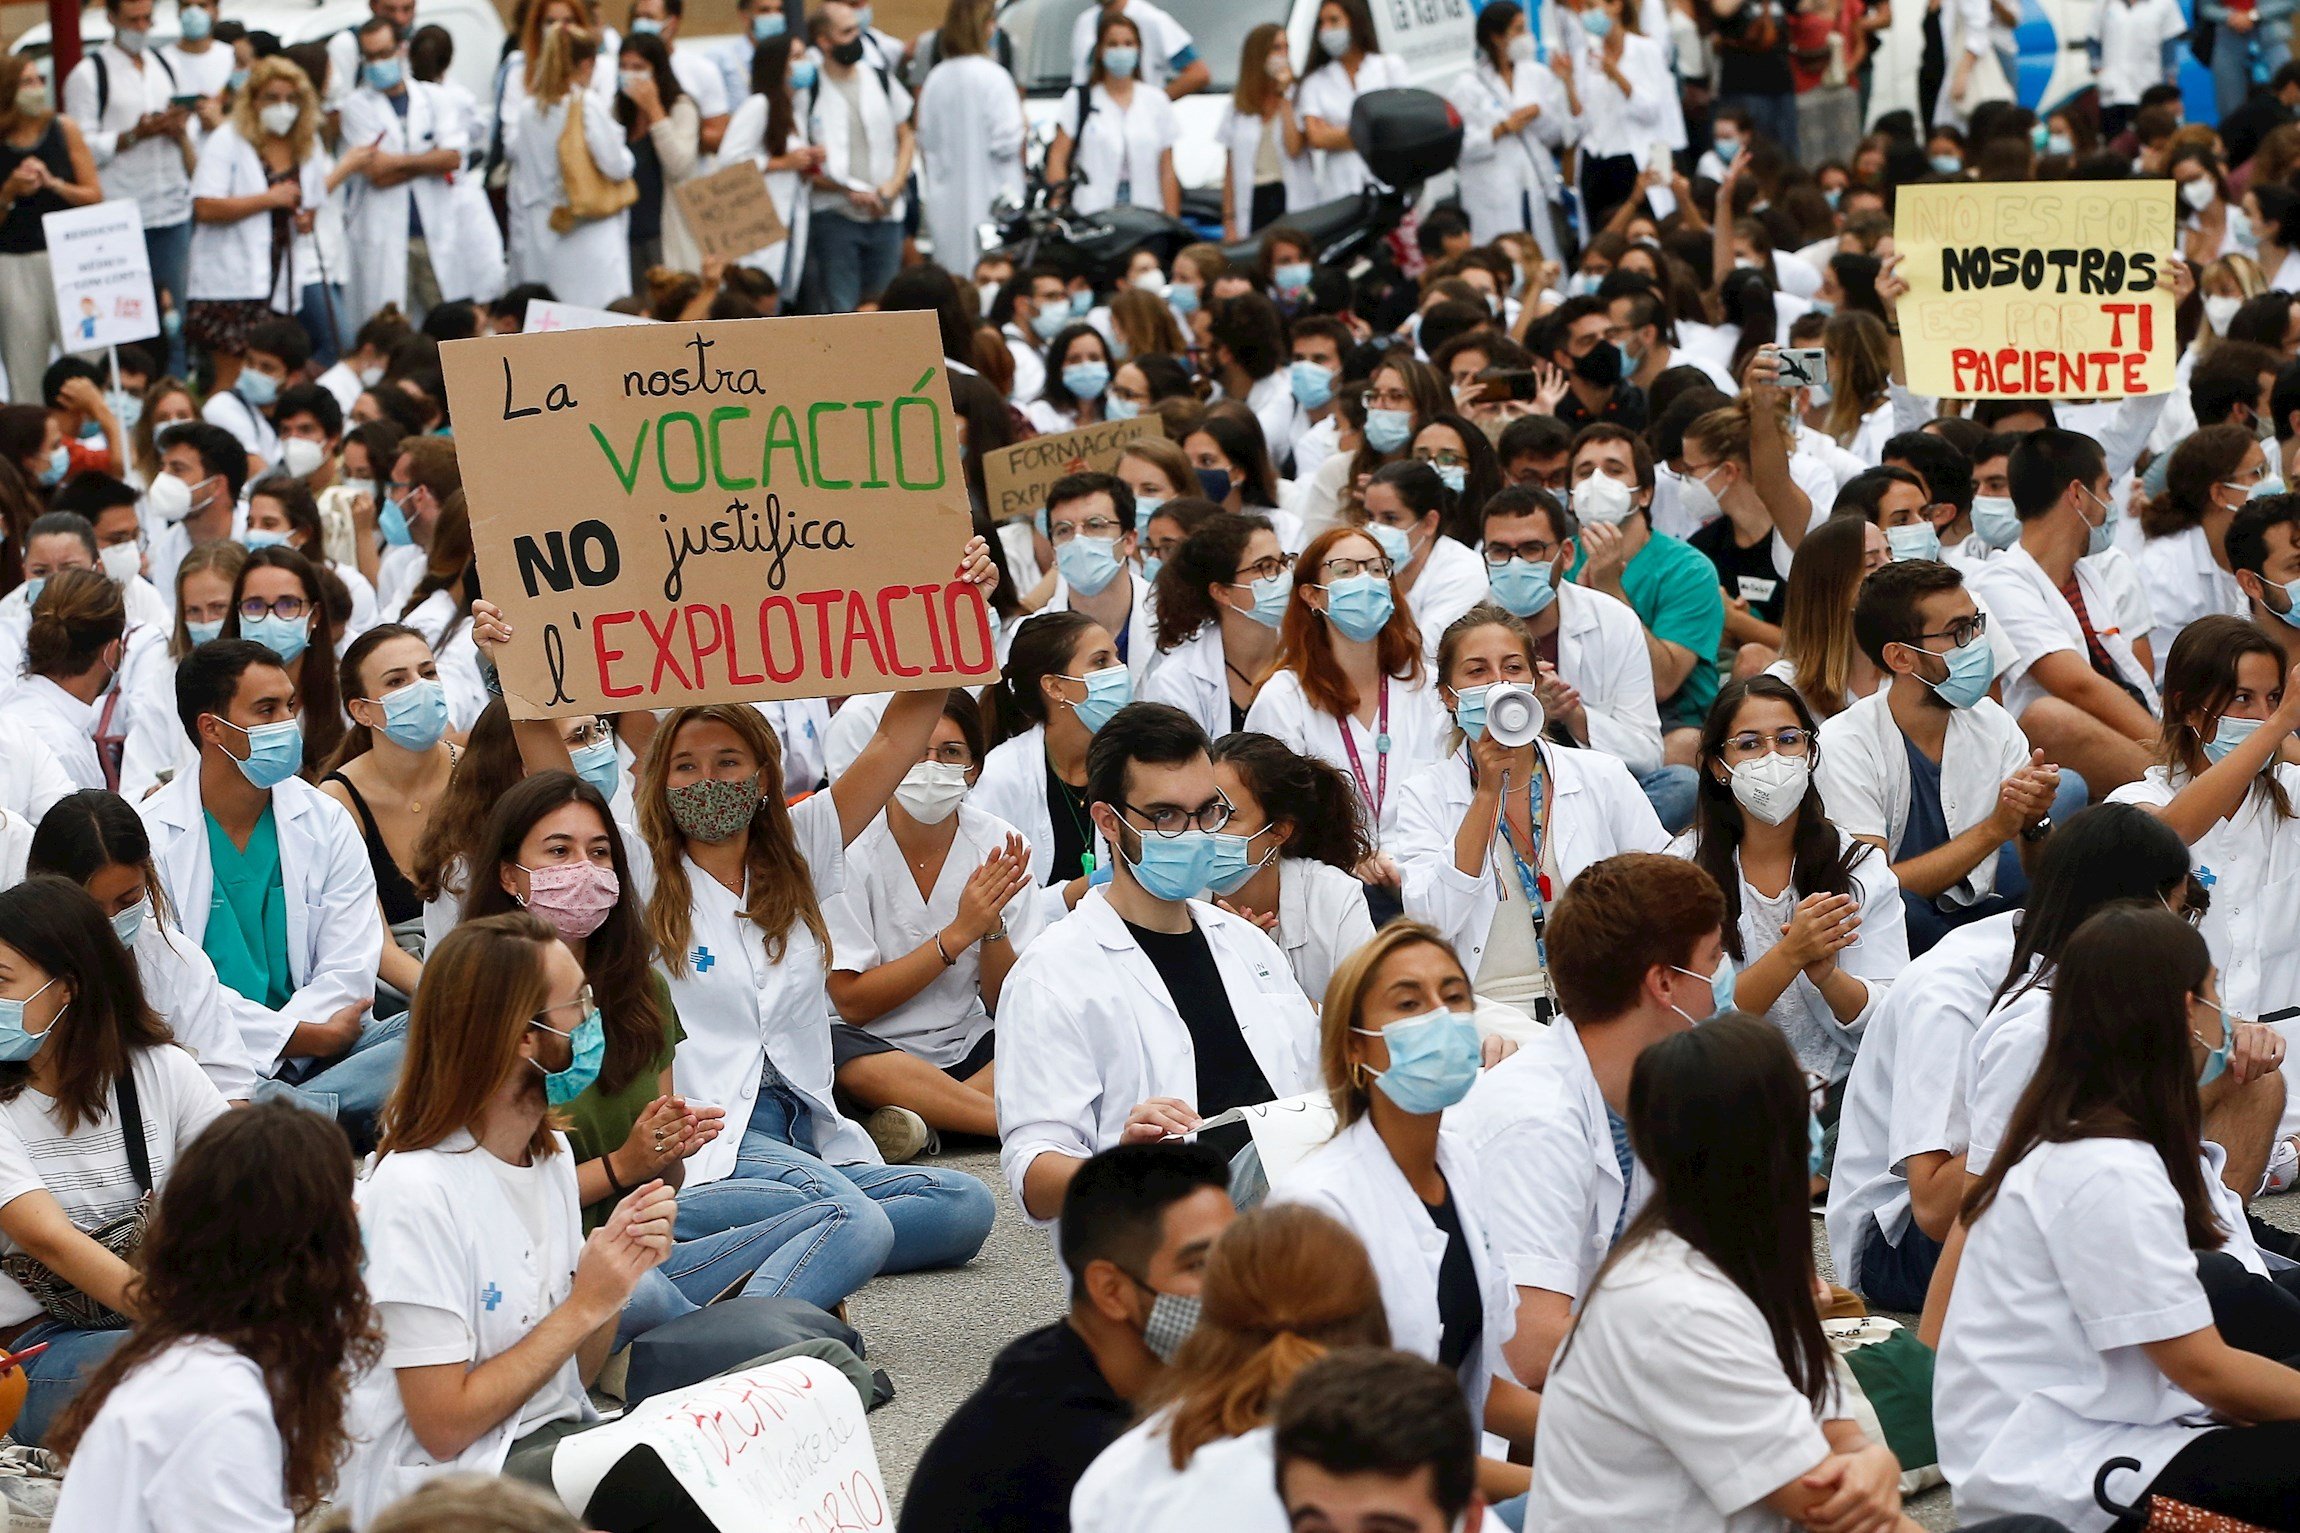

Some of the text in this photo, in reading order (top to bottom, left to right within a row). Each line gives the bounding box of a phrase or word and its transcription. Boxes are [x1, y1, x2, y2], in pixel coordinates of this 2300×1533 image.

[1911, 193, 2173, 251] NO ES POR
[1942, 246, 2158, 295] NOSOTROS
[1918, 300, 2154, 352] ES POR TI
[502, 331, 767, 421] La nostra
[1951, 348, 2149, 394] PACIENTE
[589, 367, 946, 496] VOCACIÓ
[513, 493, 855, 602] NO justifica
